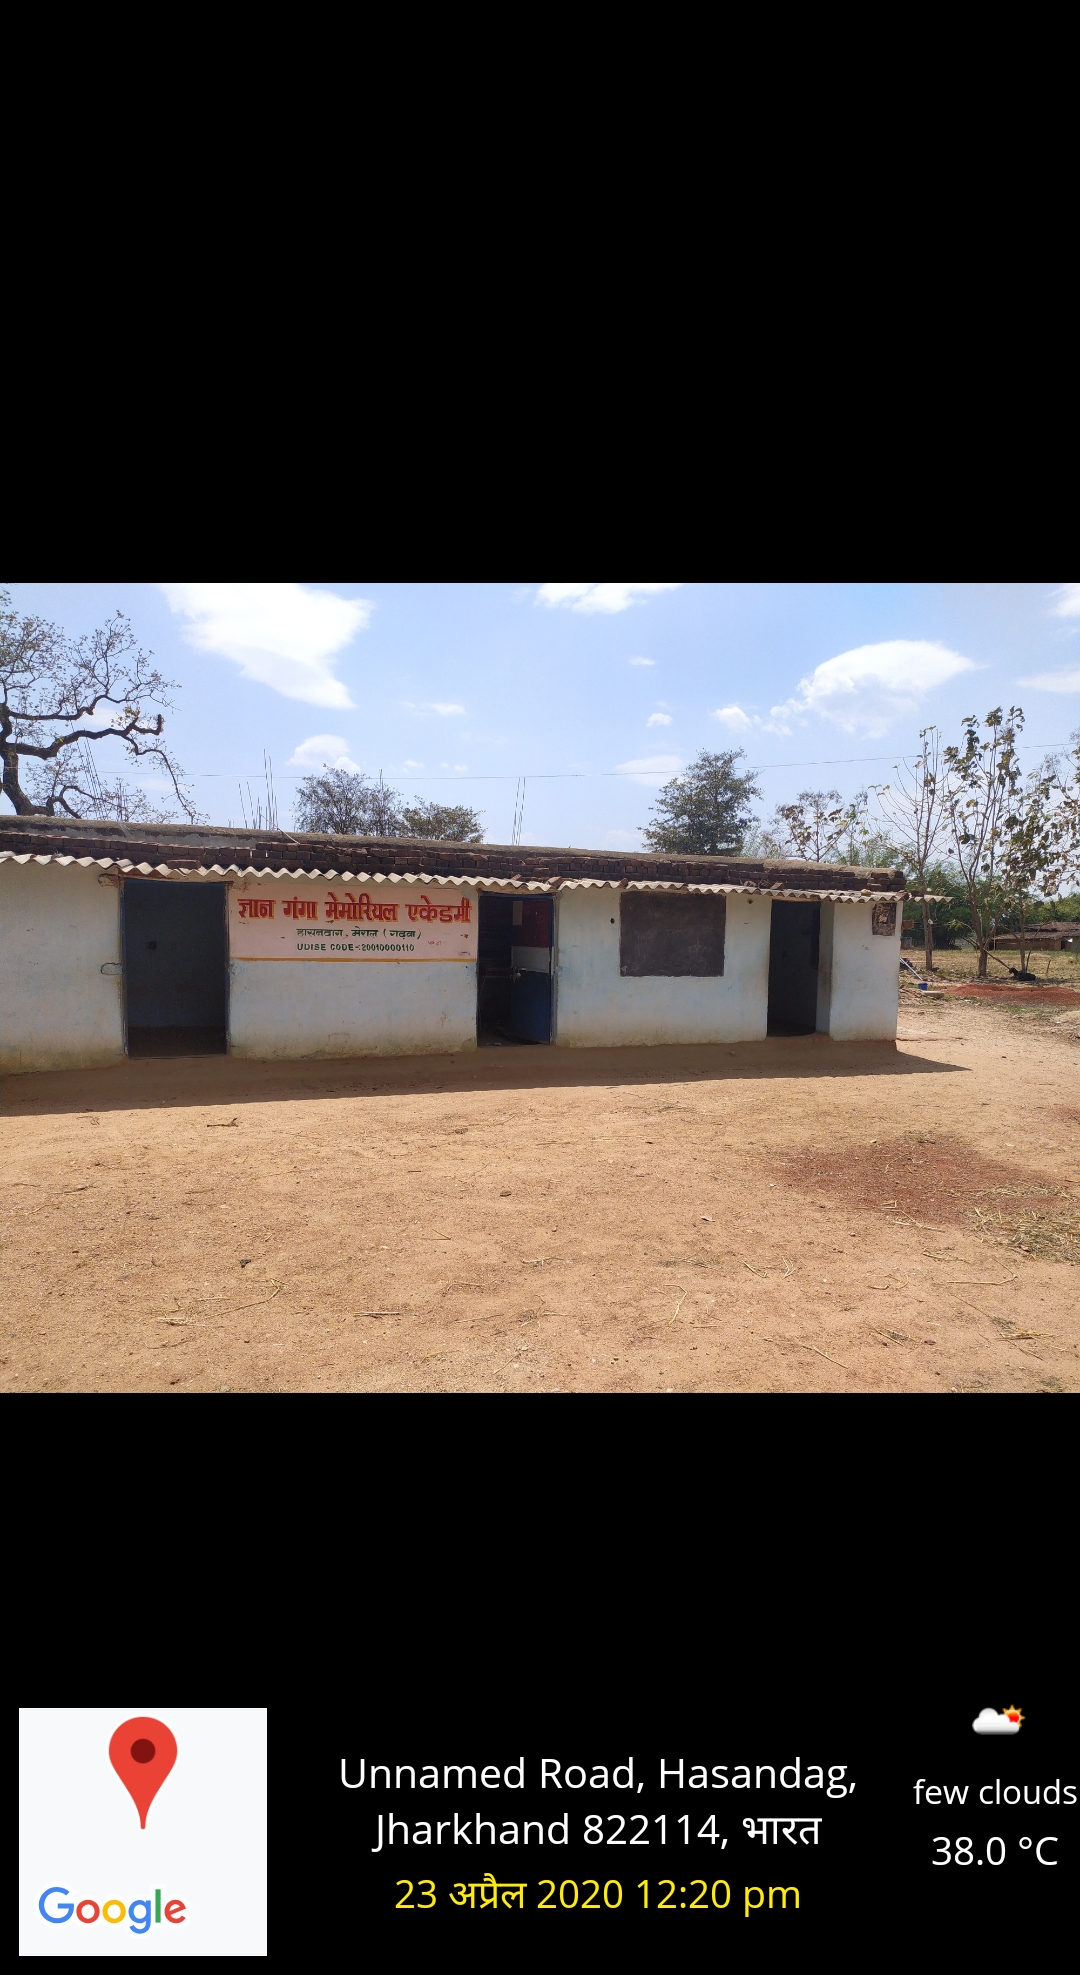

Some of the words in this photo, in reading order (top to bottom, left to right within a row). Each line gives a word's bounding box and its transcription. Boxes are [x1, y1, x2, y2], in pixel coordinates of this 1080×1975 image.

[237, 898, 276, 921] ज्ञान
[281, 896, 318, 921] गंगा
[324, 891, 400, 923] मेमोरियल
[405, 895, 472, 924] एकेडमी
[296, 943, 327, 951] UDISE
